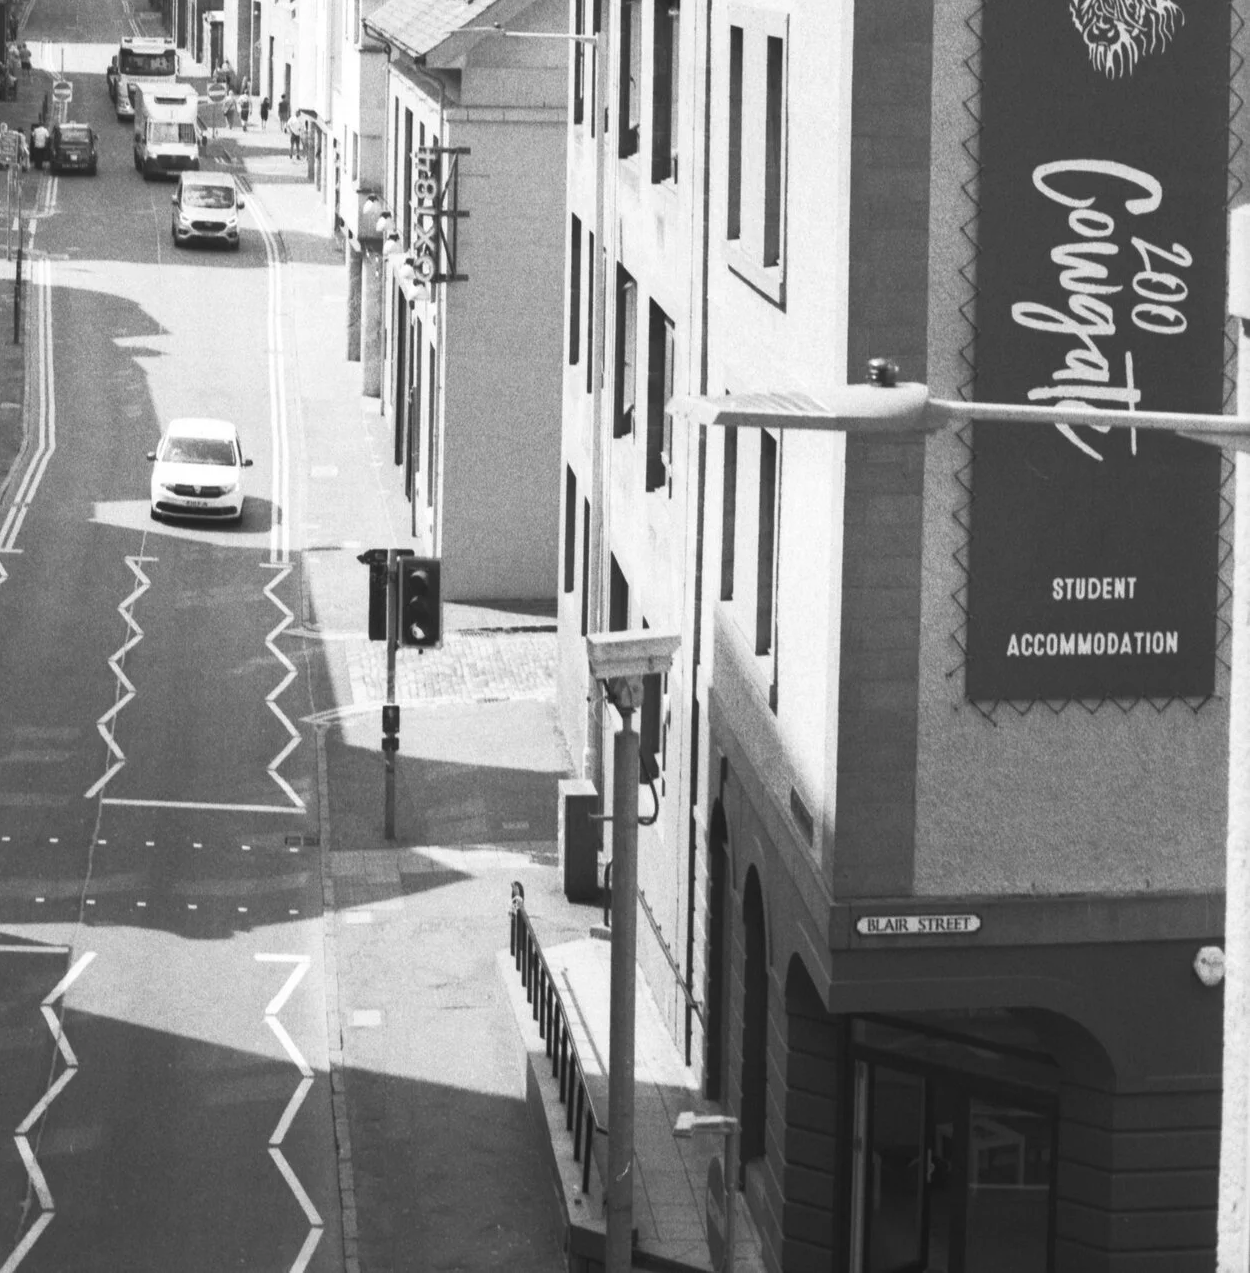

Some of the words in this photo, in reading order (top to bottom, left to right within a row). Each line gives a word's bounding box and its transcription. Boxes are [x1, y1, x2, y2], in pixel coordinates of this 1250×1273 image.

[414, 150, 437, 282] OX184
[1131, 236, 1193, 334] 200
[1052, 577, 1137, 600] STUDENT
[1007, 631, 1178, 657] ACCOMMODATION
[867, 918, 909, 932] BLAIR
[918, 917, 971, 931] STREET
